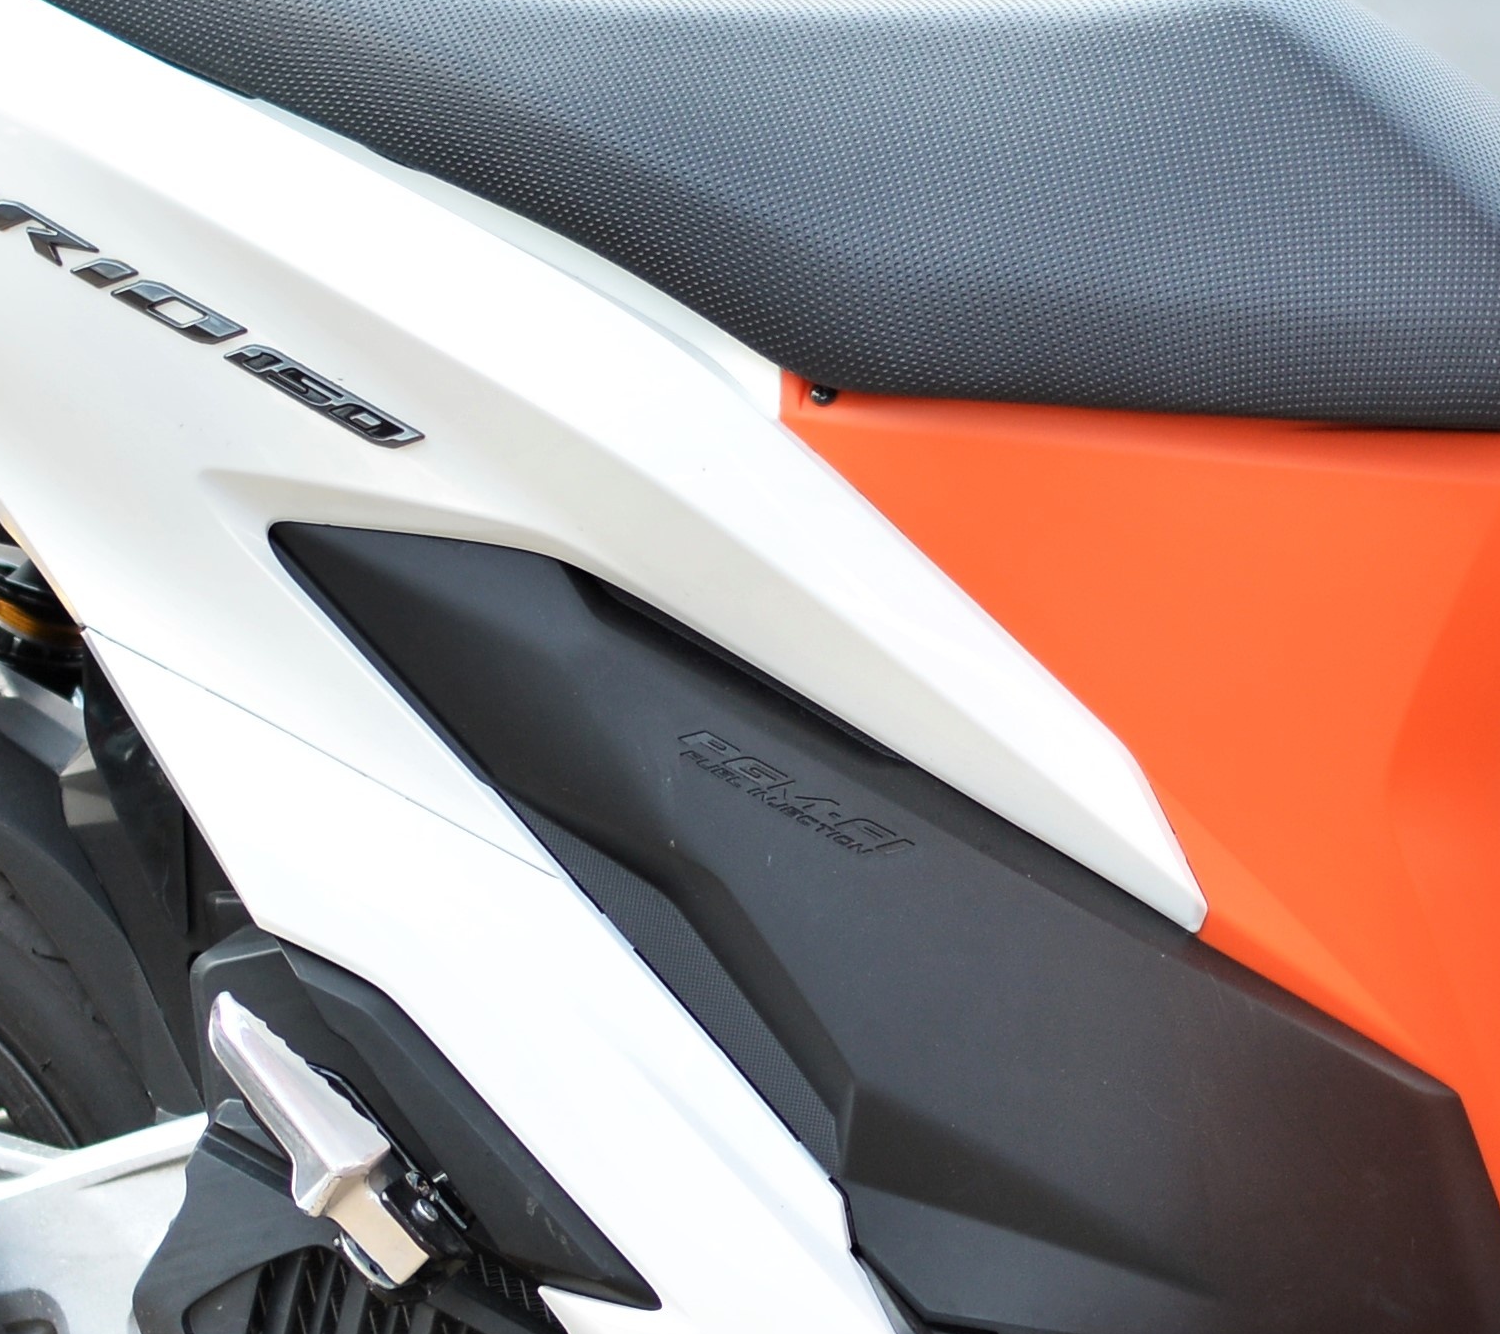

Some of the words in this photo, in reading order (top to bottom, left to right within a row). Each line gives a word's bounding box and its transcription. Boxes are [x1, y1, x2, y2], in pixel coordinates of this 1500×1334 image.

[224, 344, 426, 449] 150
[680, 749, 743, 789] FUEL
[746, 786, 875, 856] INJECTION
